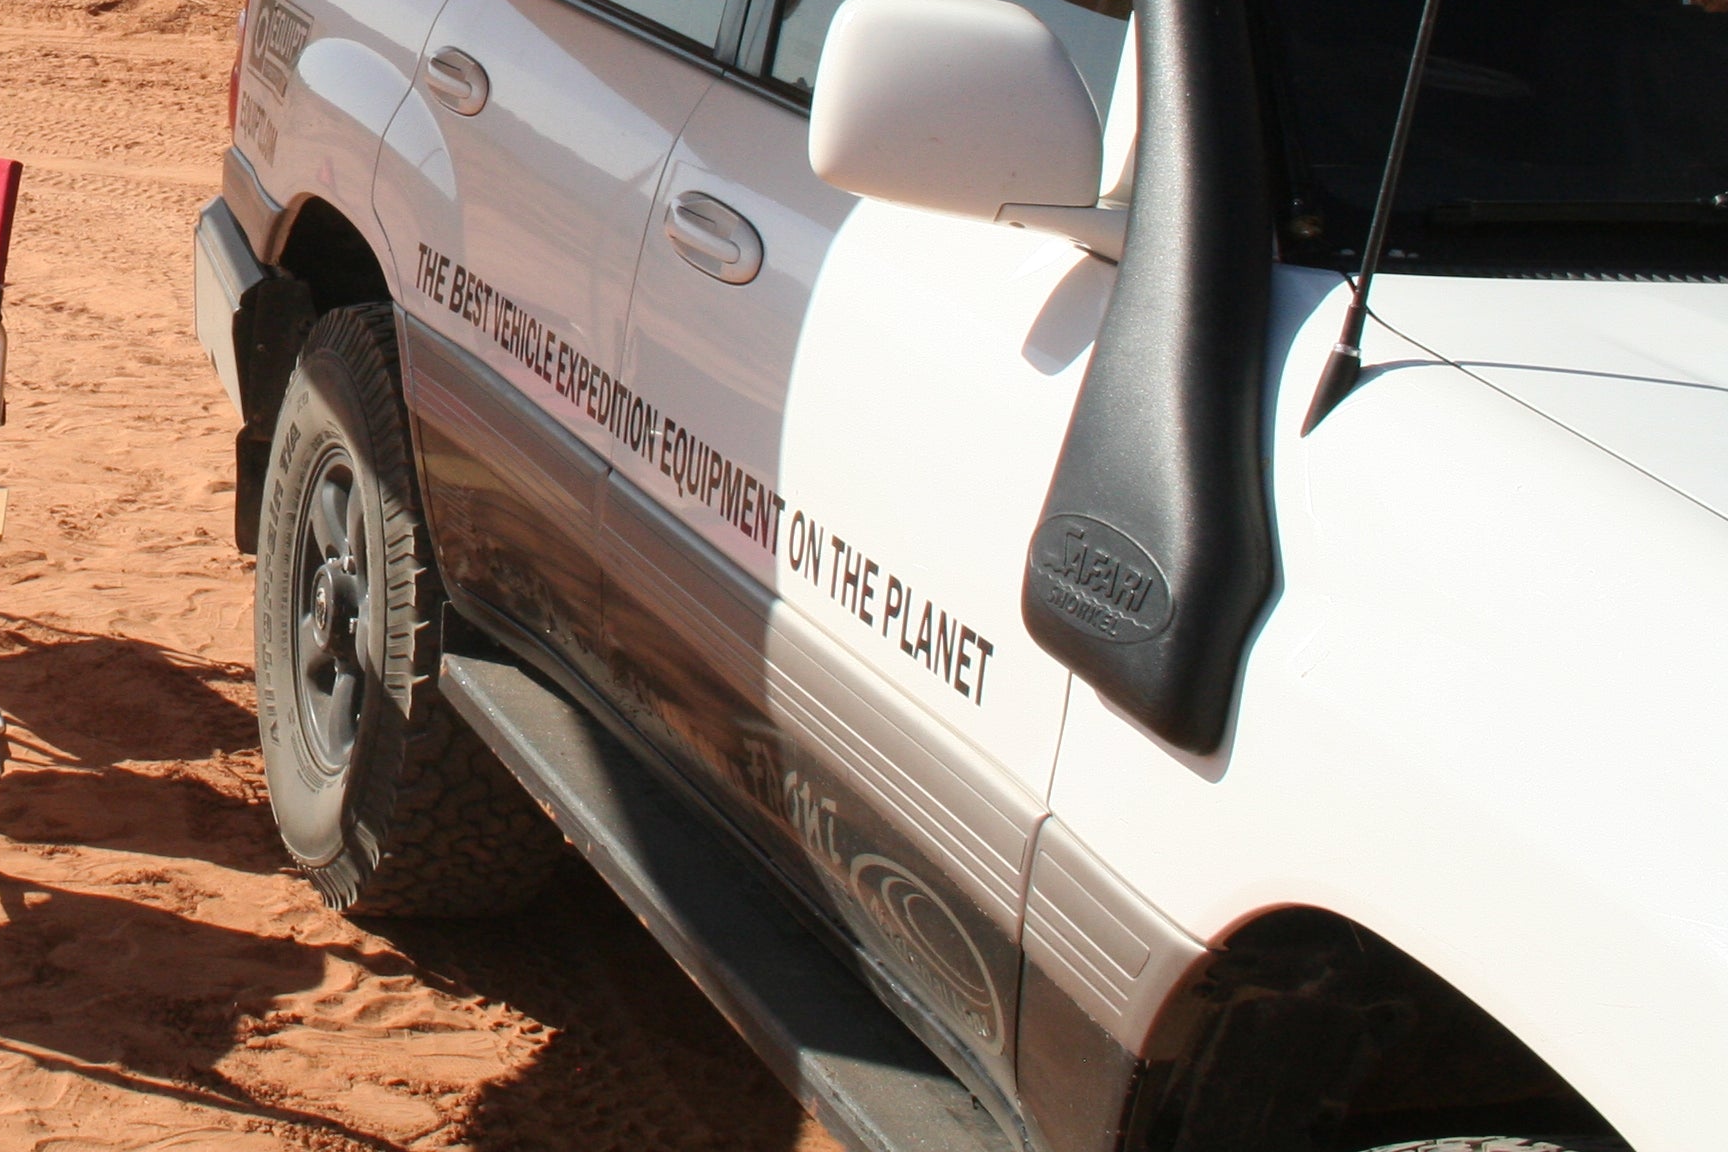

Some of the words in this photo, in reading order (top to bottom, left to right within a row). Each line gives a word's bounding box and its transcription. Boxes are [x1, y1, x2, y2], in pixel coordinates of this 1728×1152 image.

[416, 242, 450, 304] THE
[449, 264, 493, 333] BEST
[494, 291, 556, 384] VEHICLE
[555, 340, 658, 463] EXPEDITION
[660, 417, 786, 556] EQUIPMENT
[789, 509, 824, 587] ON
[830, 534, 879, 628] THE
[882, 574, 994, 707] PLANET
